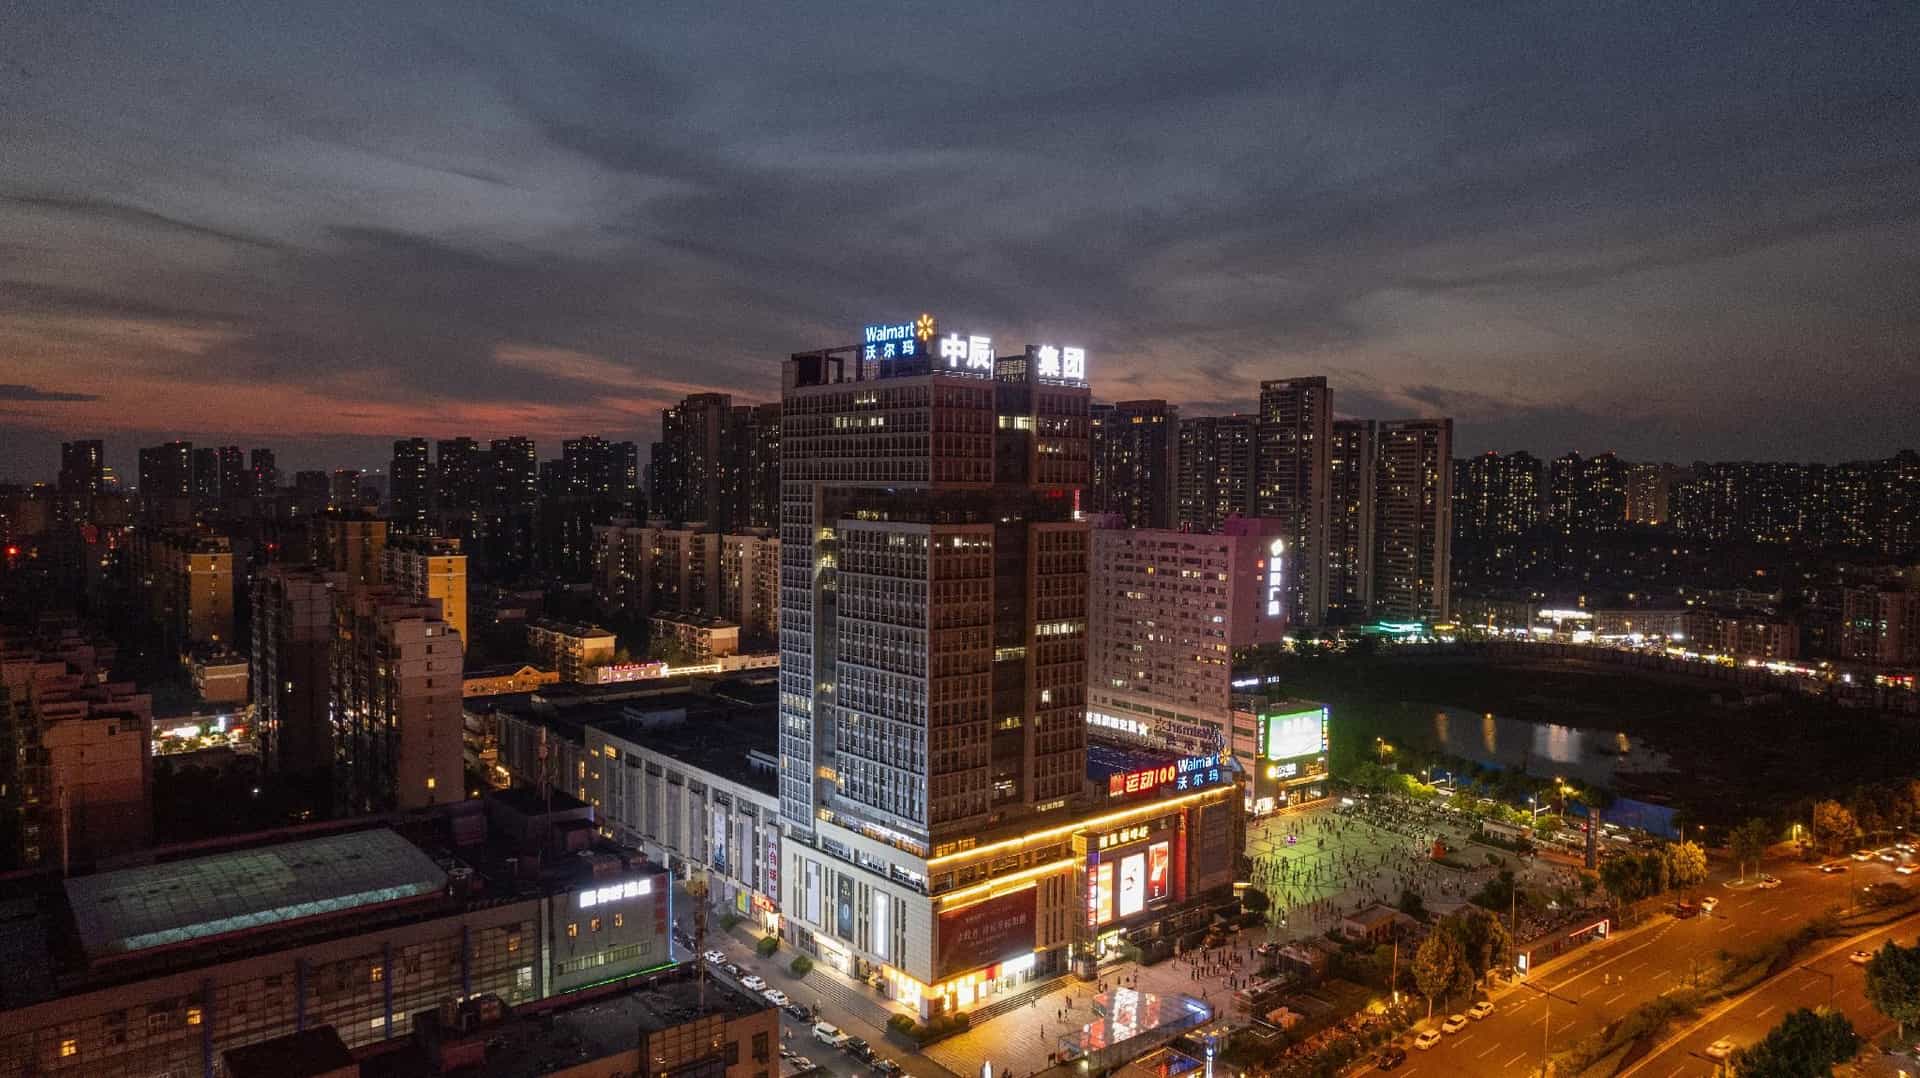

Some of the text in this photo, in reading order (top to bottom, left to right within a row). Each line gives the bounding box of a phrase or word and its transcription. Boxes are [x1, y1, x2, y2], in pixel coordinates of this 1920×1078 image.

[865, 322, 915, 342] Walmart
[865, 341, 915, 360] 沃尔玛
[941, 333, 1085, 379] 中辰 集团
[1177, 752, 1221, 773] Walmart
[1126, 765, 1176, 793] 运动100
[1177, 769, 1219, 791] 沃尔玛
